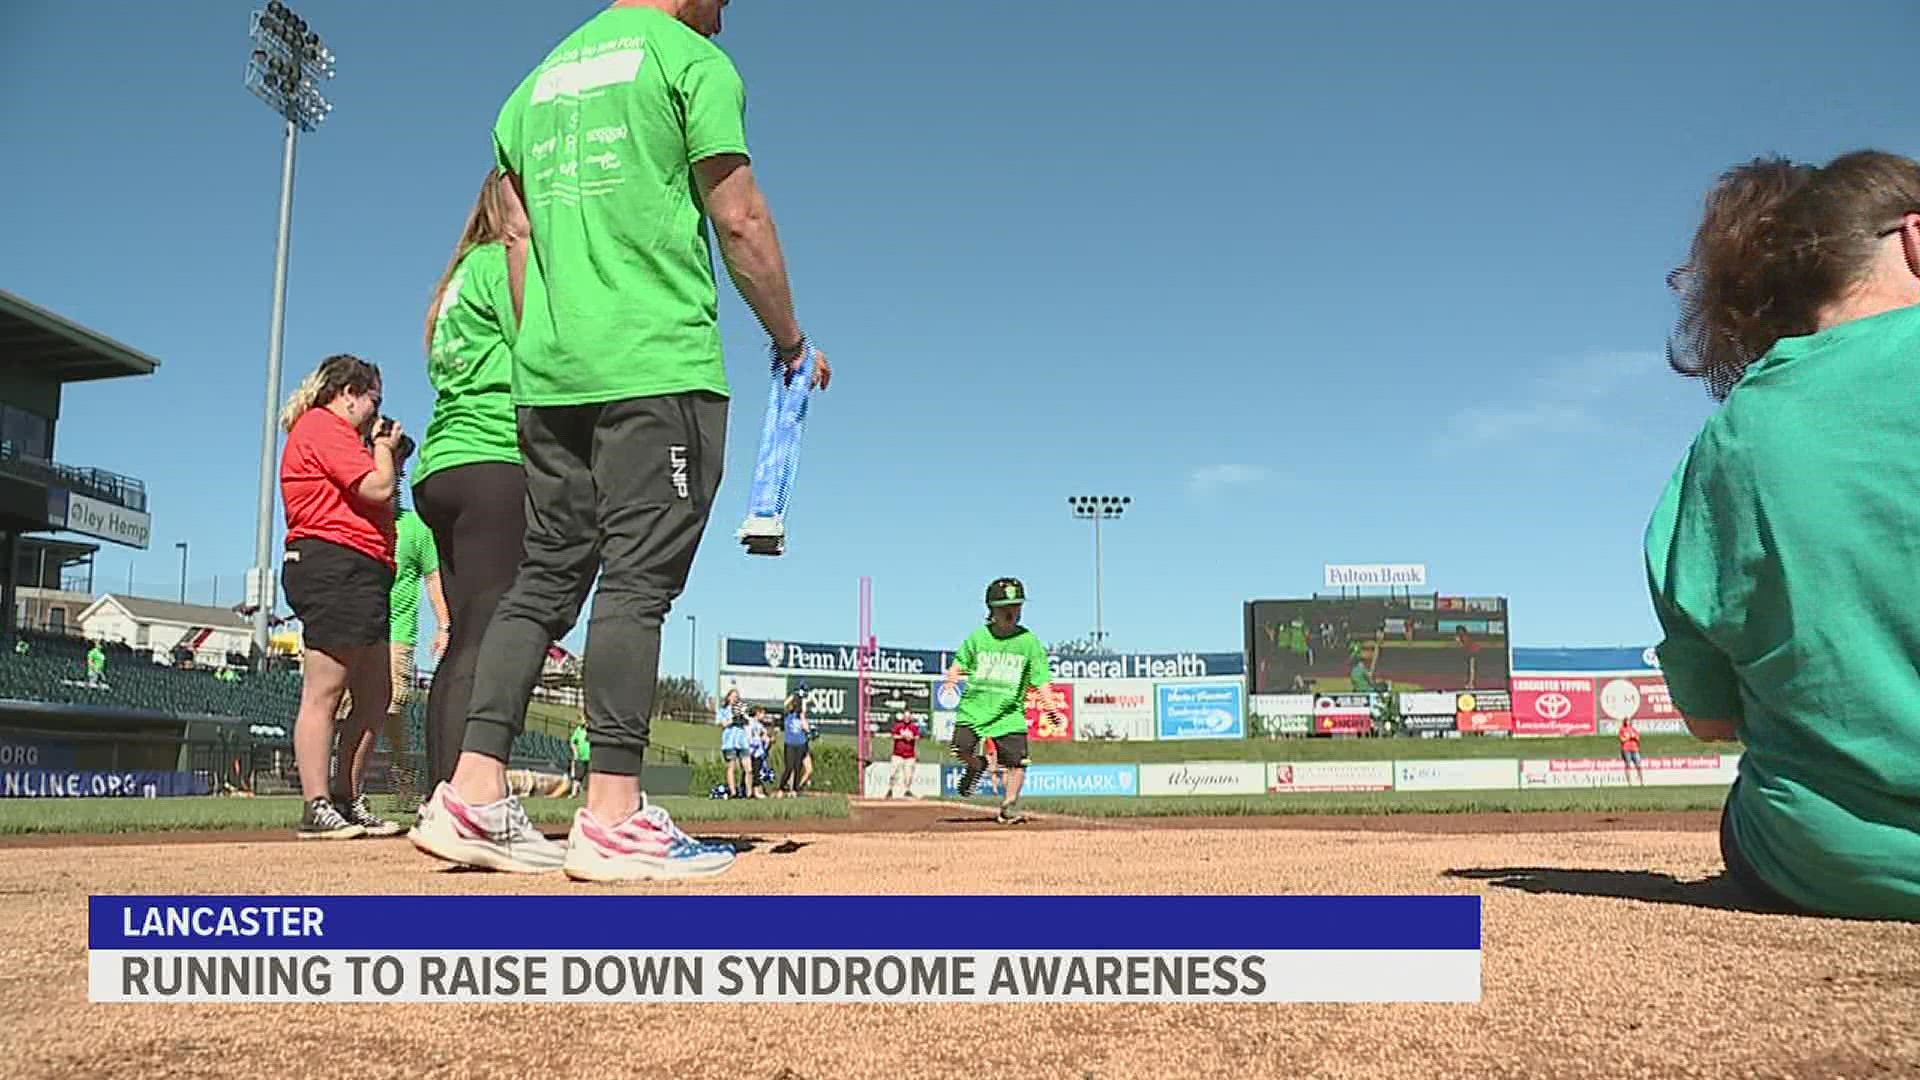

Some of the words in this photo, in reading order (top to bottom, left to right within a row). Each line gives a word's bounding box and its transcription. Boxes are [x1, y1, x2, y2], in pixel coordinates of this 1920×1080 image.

[72, 503, 104, 532] Oley
[109, 512, 149, 542] Hemp
[1330, 567, 1378, 584] Fulton
[1381, 567, 1421, 583] Bank
[788, 645, 834, 668] Penn
[837, 647, 924, 674] Medicine
[1048, 654, 1127, 678] General
[1135, 652, 1206, 677] Health
[1168, 767, 1240, 791] Wegmans
